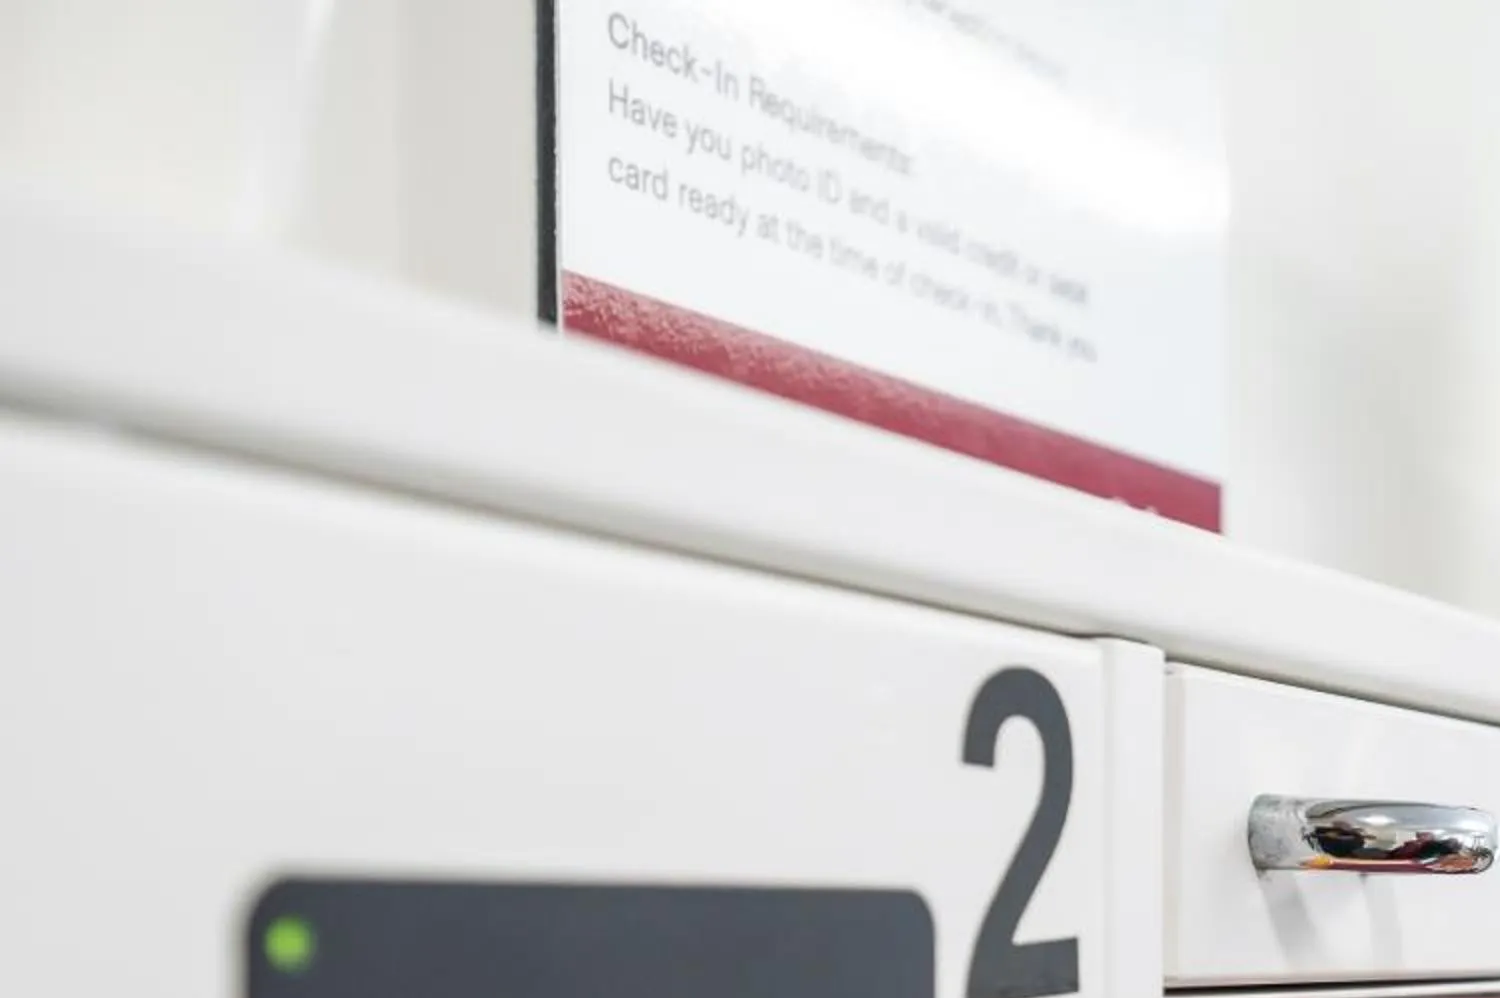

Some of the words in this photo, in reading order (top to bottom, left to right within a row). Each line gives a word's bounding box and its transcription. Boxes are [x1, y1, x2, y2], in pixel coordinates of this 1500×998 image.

[607, 12, 740, 103] Check-In
[608, 77, 678, 138] Have
[685, 119, 733, 161] you
[742, 143, 811, 192] photo
[817, 168, 843, 204] ID
[608, 155, 669, 201] card
[678, 183, 750, 238] ready
[756, 213, 780, 247] at
[786, 218, 824, 261] the
